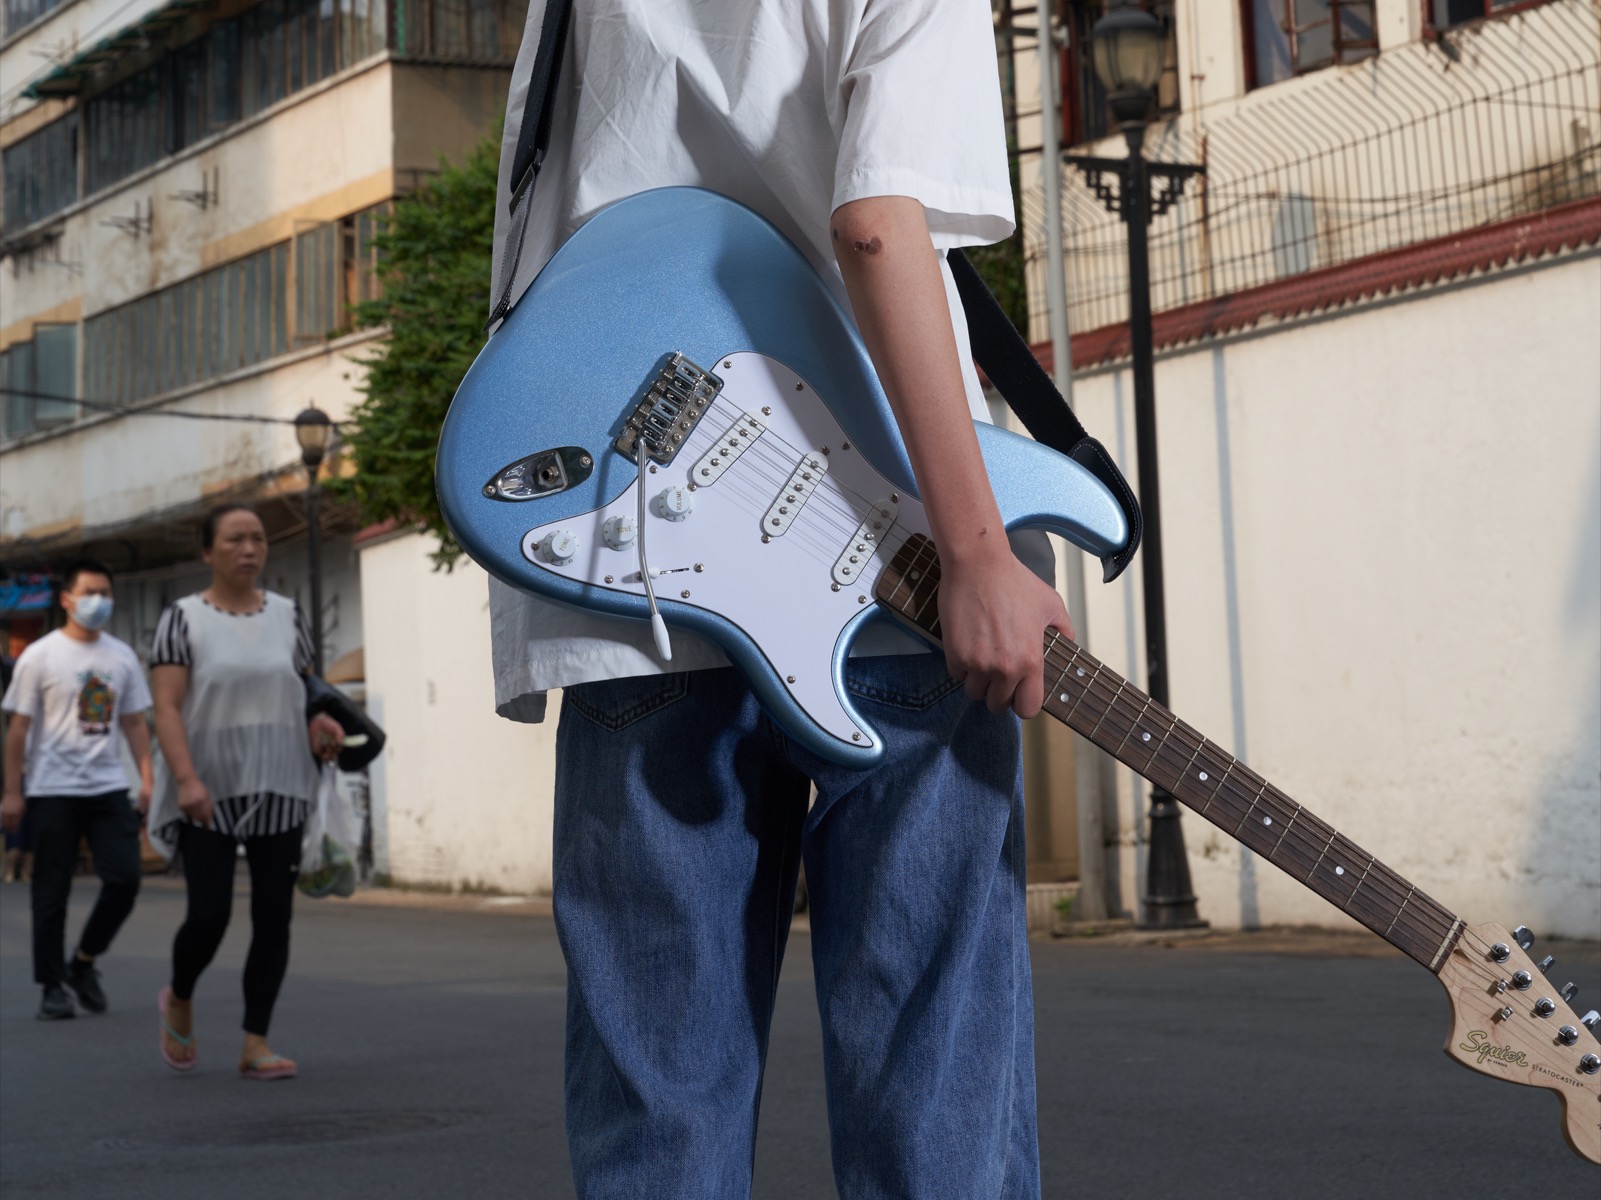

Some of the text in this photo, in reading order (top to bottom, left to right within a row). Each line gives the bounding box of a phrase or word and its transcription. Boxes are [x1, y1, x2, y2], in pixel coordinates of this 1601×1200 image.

[617, 525, 632, 534] TONE
[559, 537, 571, 552] TONE
[1459, 1030, 1528, 1067] Squier
